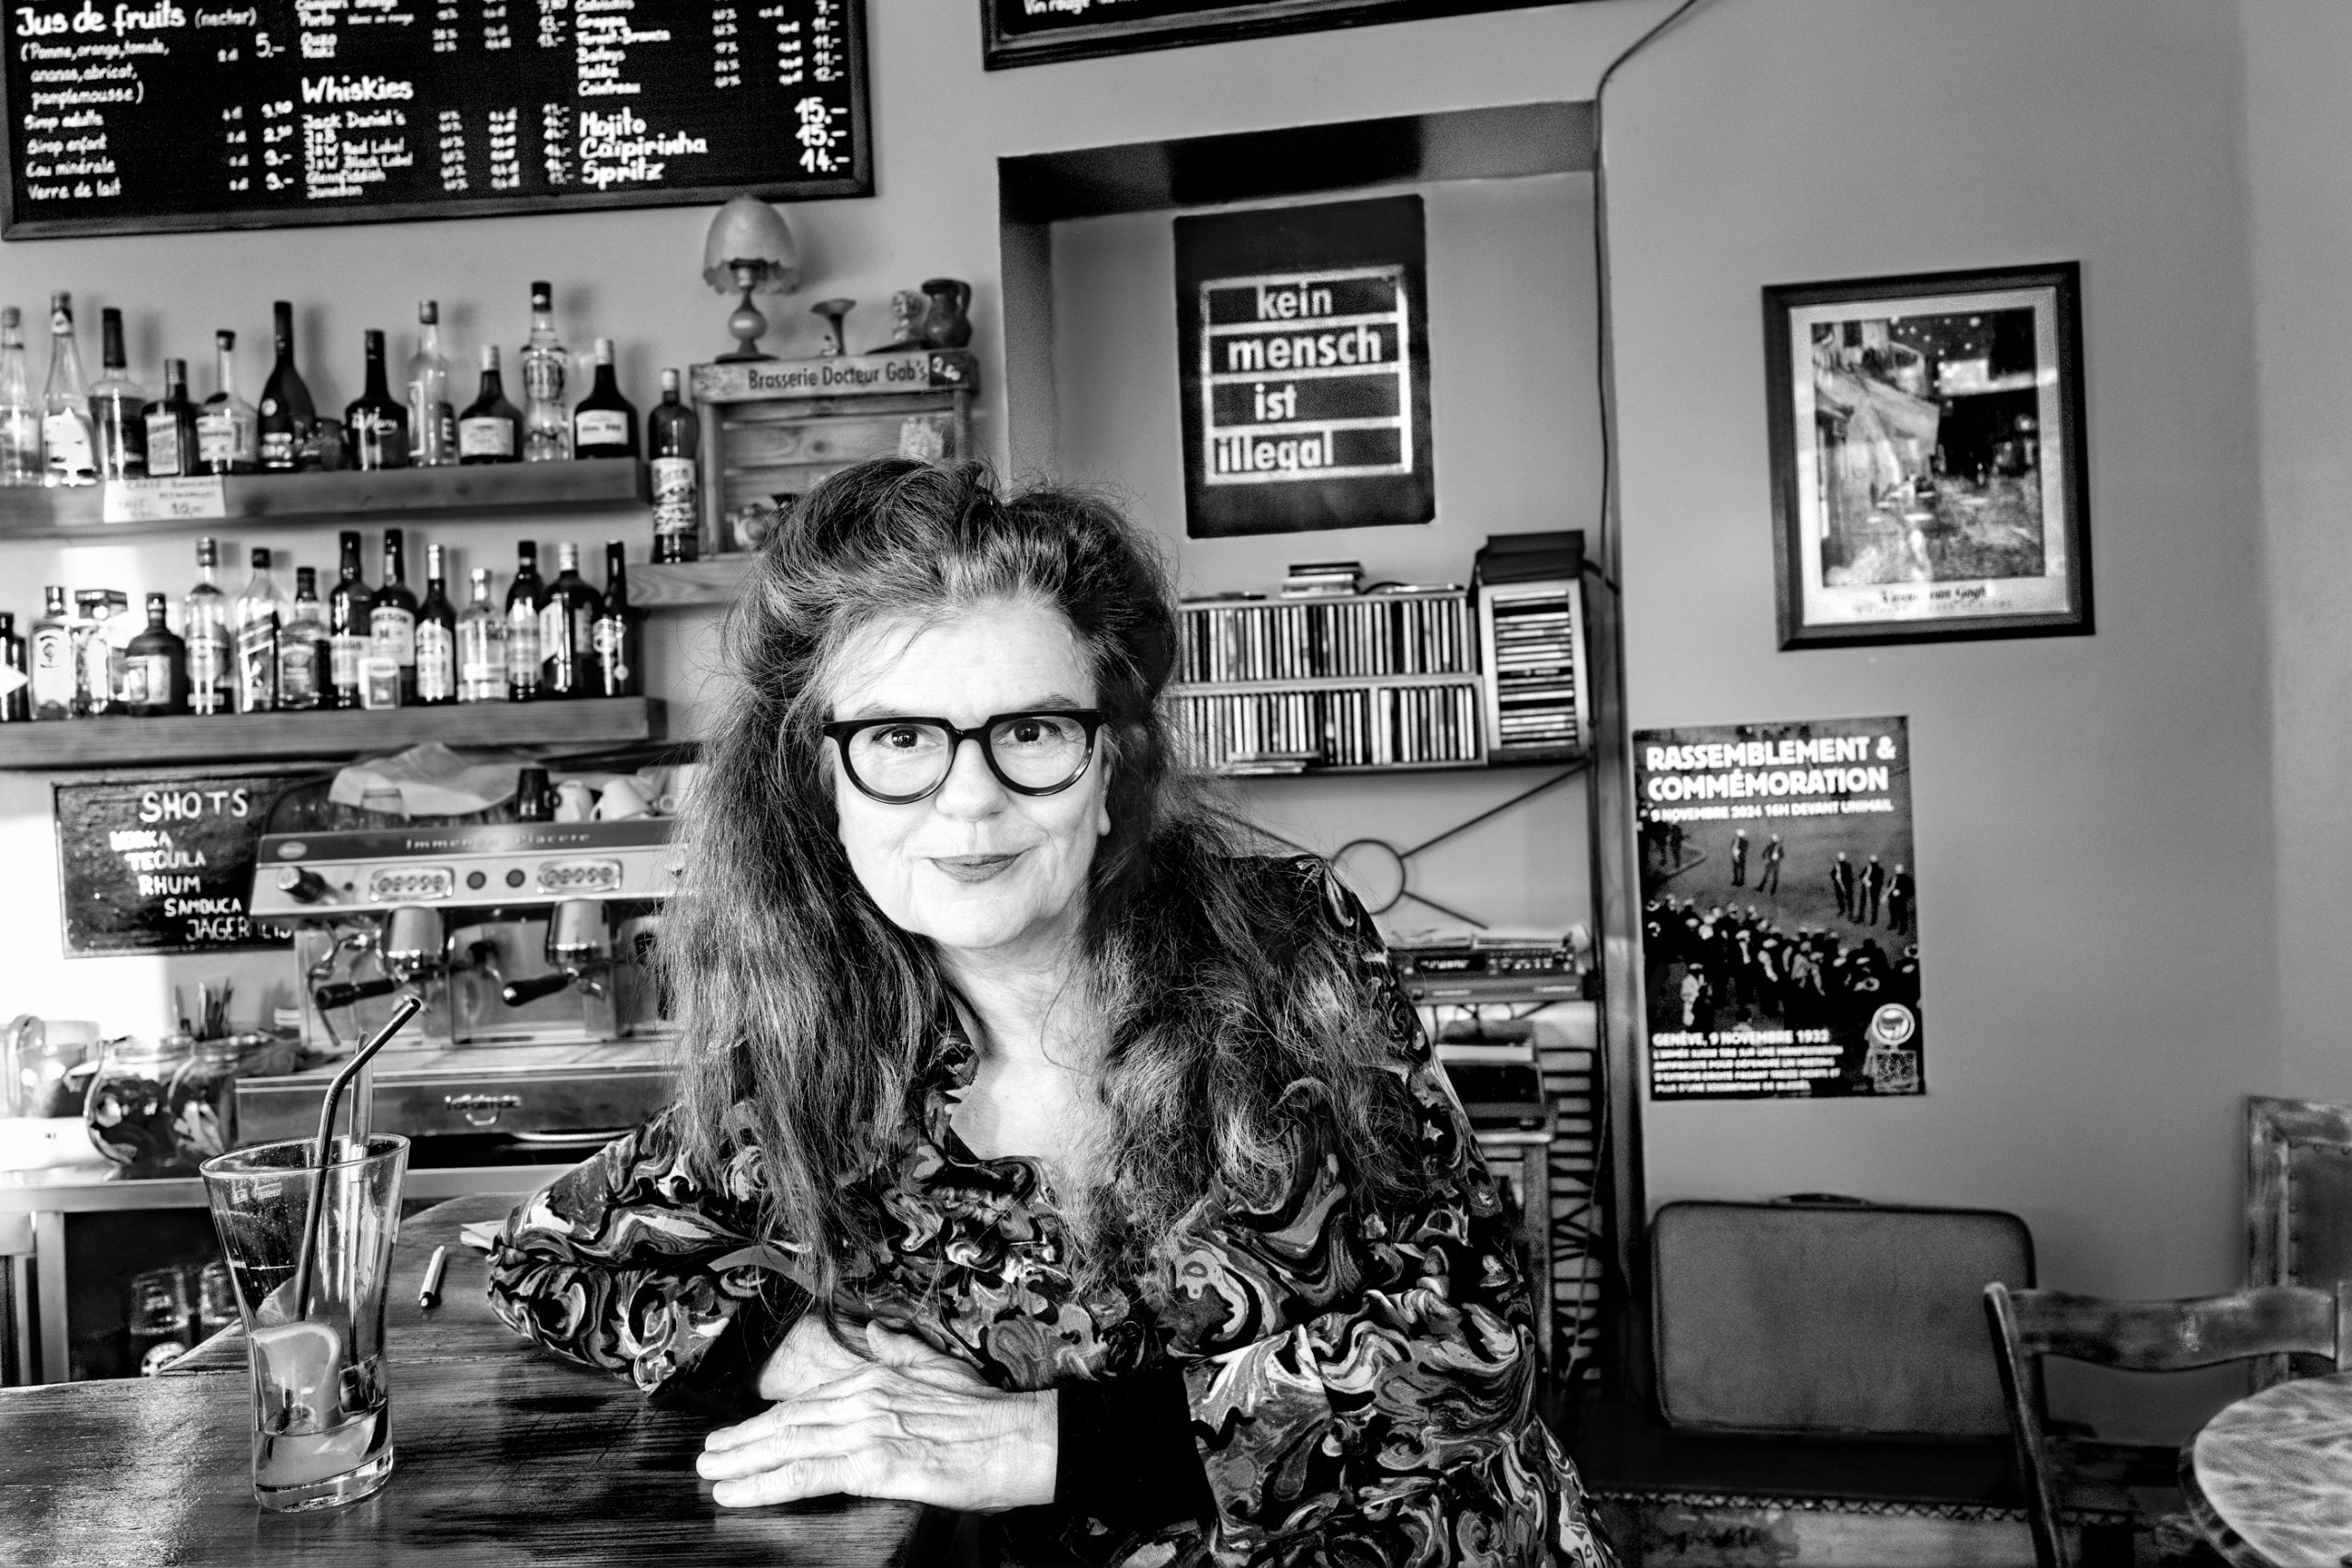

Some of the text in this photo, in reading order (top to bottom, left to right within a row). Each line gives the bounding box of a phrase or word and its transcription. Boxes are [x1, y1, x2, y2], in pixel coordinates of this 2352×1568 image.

[16, 0, 257, 37] Jus de fruits (nectar)
[301, 74, 413, 103] Whiskies
[301, 112, 343, 130] Jack
[579, 106, 647, 141] Mojito
[579, 130, 708, 164] Caipirinha
[26, 161, 52, 178] Eau
[582, 156, 665, 190] Spritz
[27, 184, 71, 200] Verre
[74, 180, 93, 198] de
[1256, 282, 1332, 320] kein
[1227, 323, 1382, 370] mensch
[748, 360, 929, 389] Brasserie Docteur Gab's
[1253, 382, 1297, 421] ist
[1217, 432, 1332, 473] illegal
[1645, 736, 1896, 772] RASSEMBLEMENT &
[1647, 766, 1889, 801] COMMÉMORATION
[140, 788, 248, 823] SHOTS
[1660, 806, 1729, 821] NOVEMBRE
[1791, 801, 1839, 816] DEVANT
[137, 874, 201, 897] RHUM
[1720, 1030, 1793, 1046] NOVEMBRE
